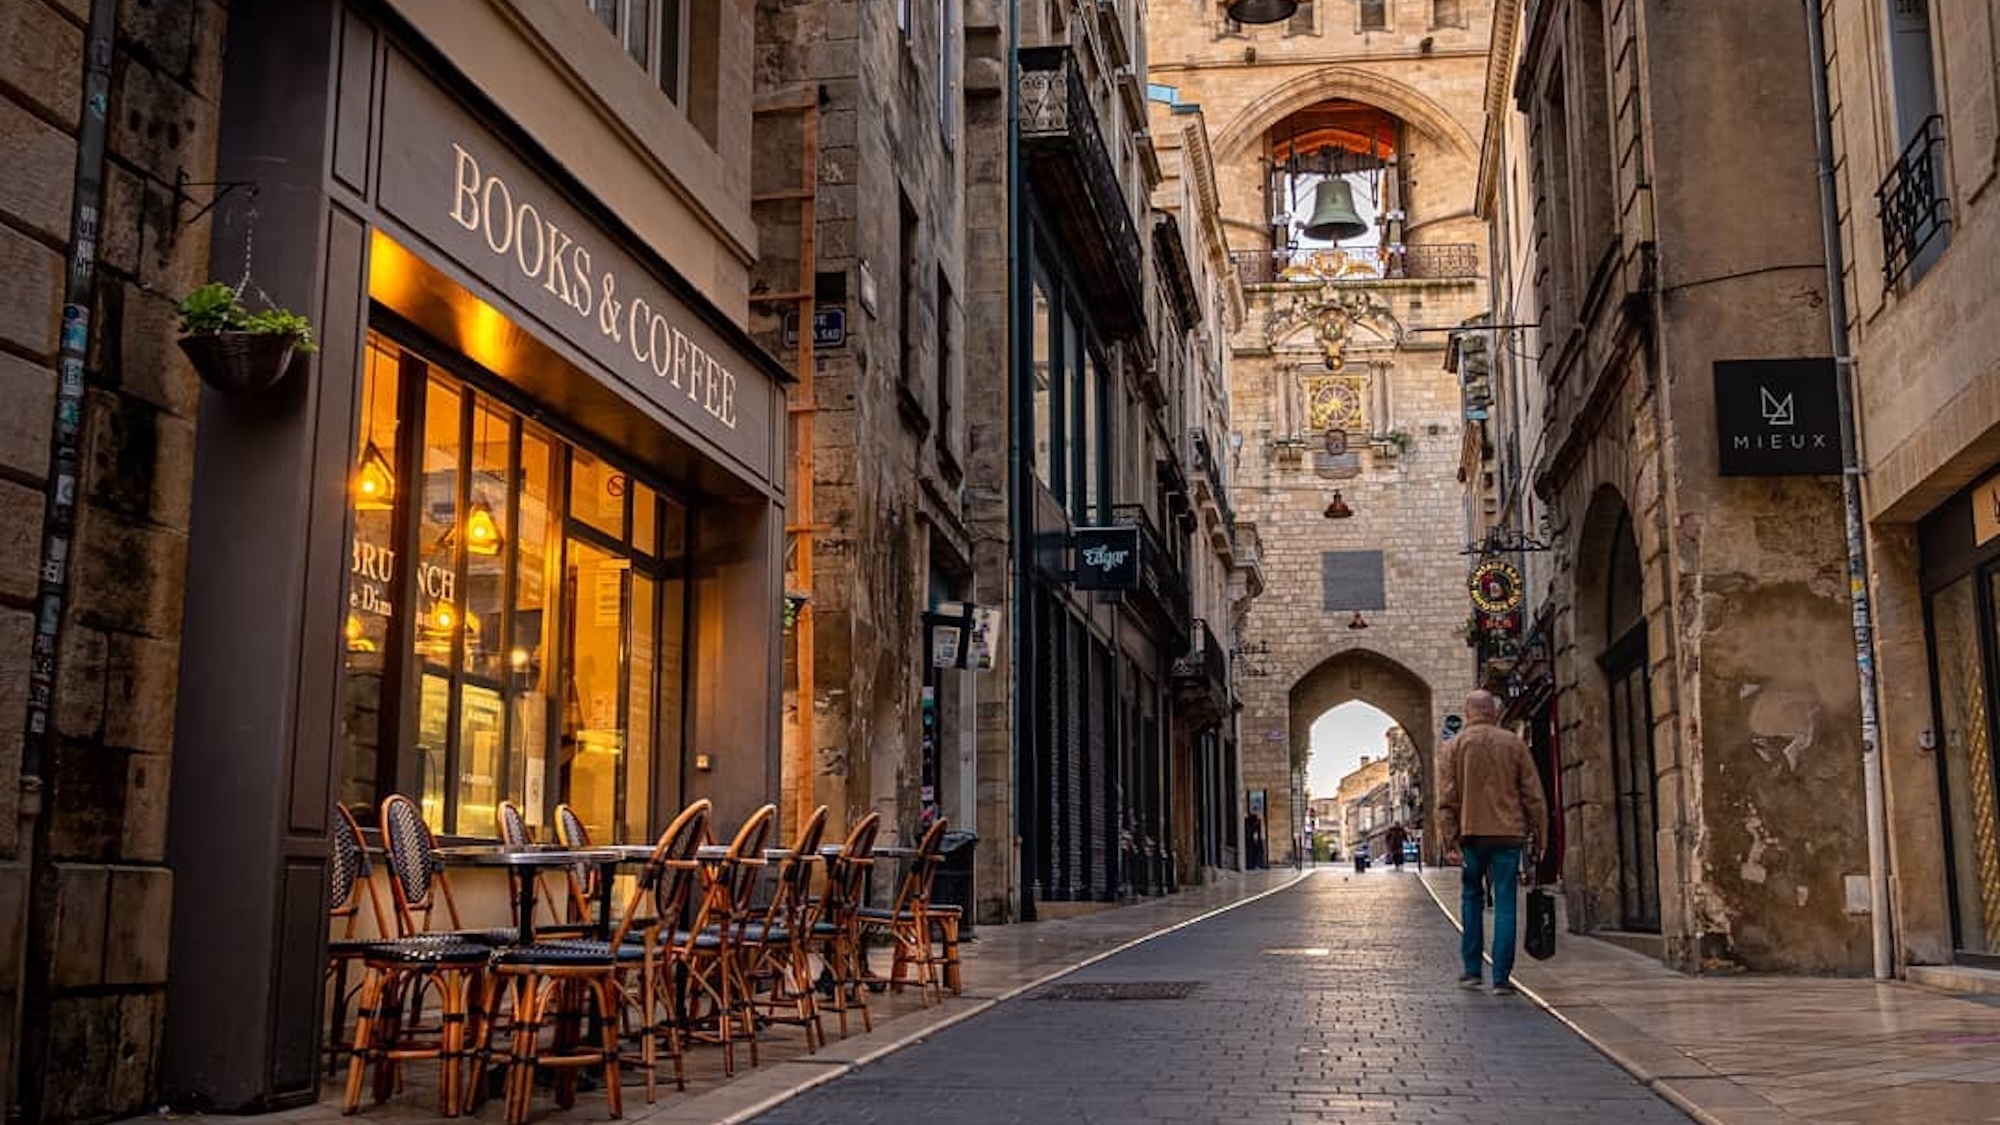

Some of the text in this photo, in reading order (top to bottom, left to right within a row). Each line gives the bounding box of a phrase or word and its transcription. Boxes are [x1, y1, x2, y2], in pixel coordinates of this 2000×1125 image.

[449, 143, 738, 430] BOOKS & COFFEE
[1733, 434, 1826, 449] MIEUX
[1082, 544, 1129, 572] Edgar
